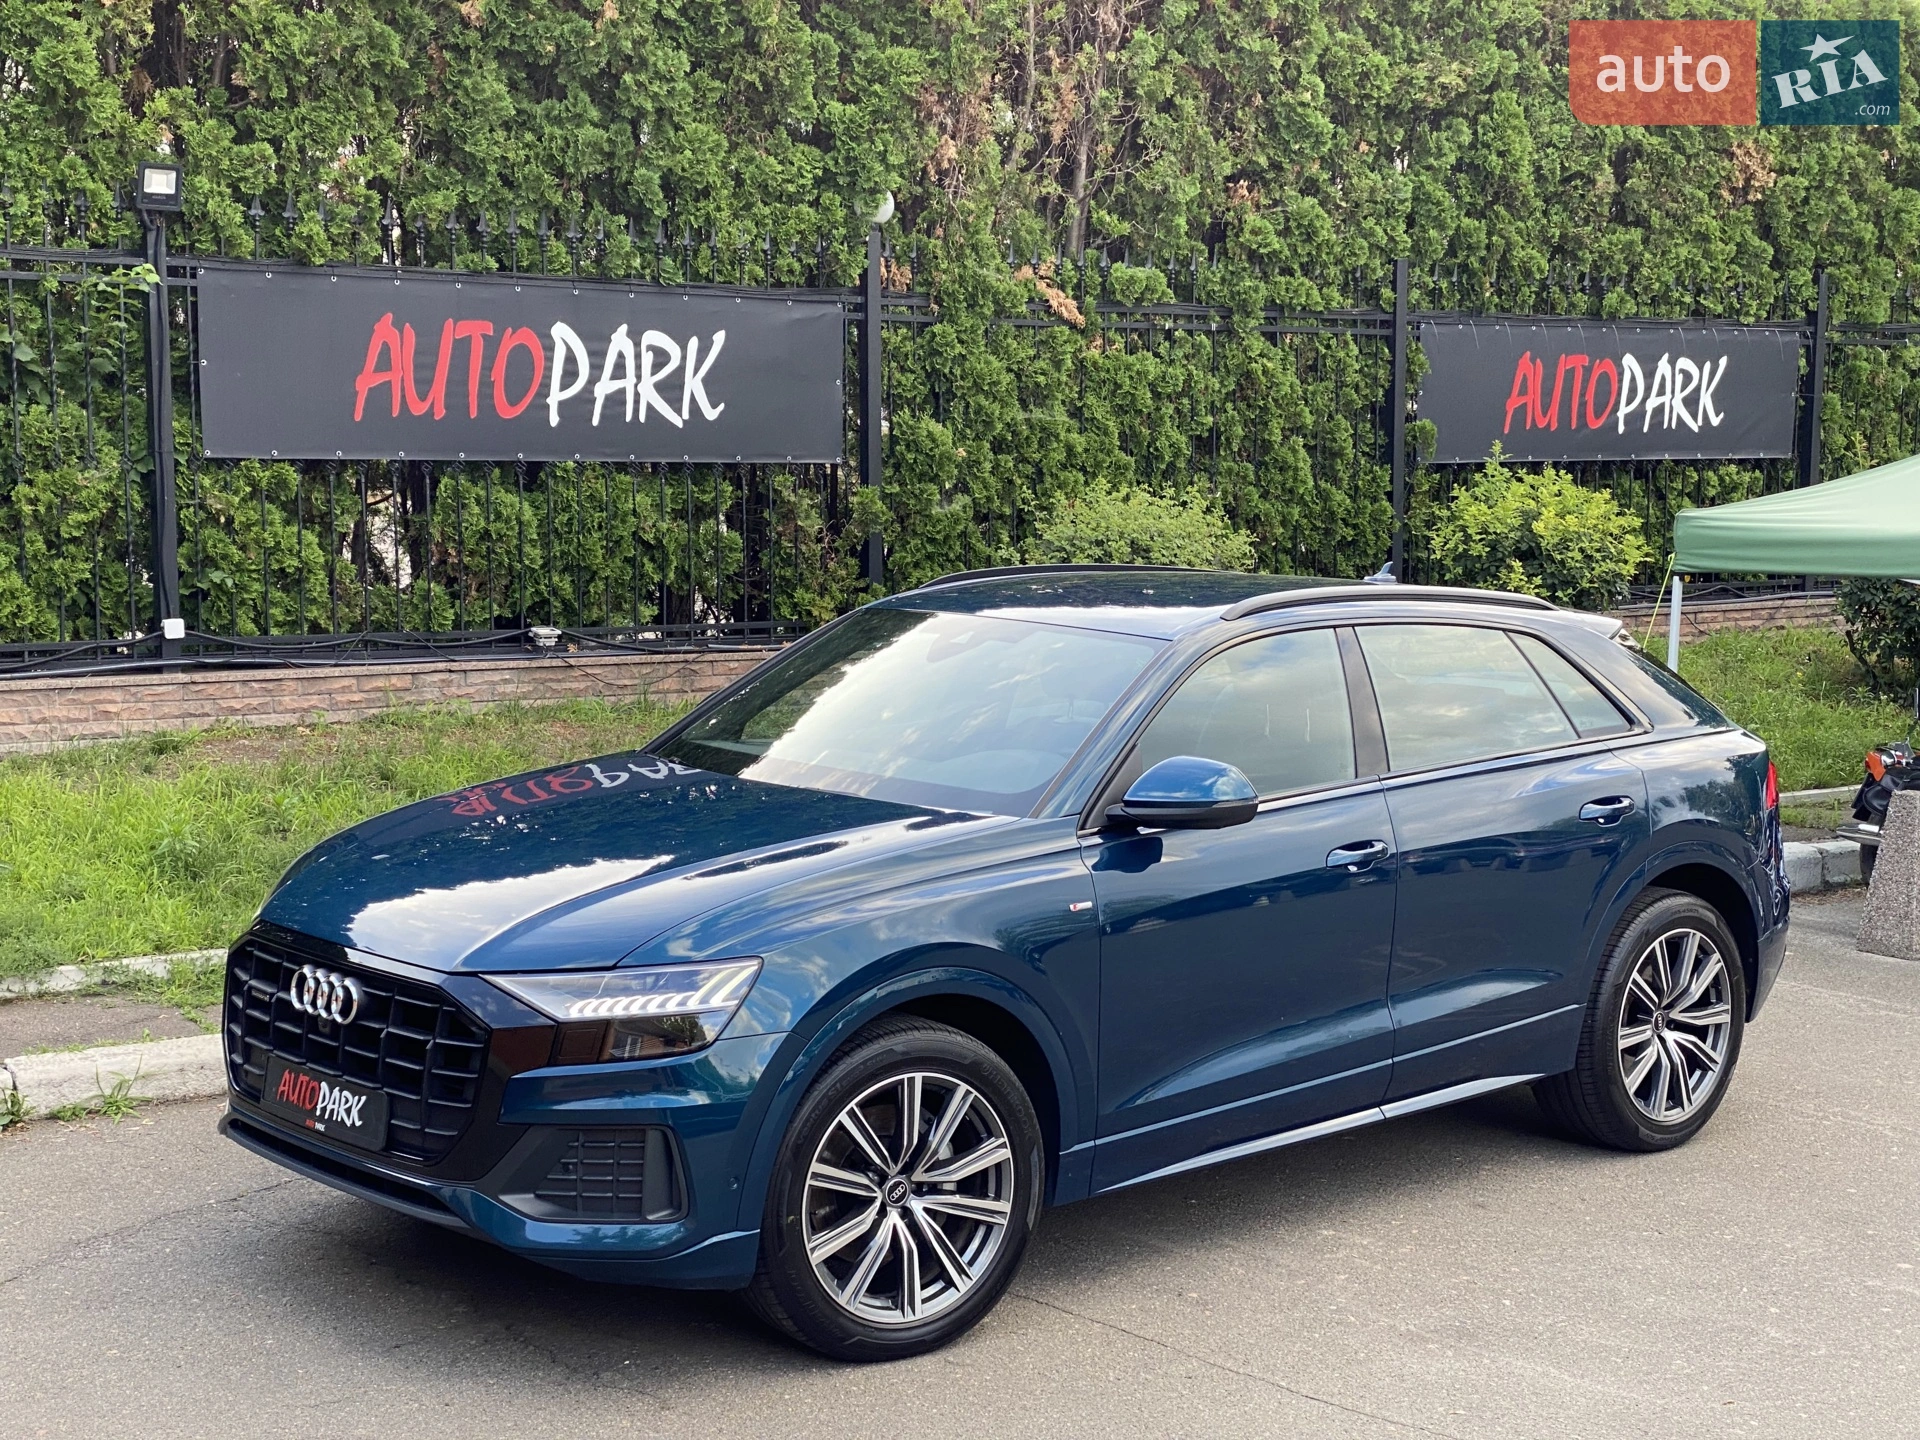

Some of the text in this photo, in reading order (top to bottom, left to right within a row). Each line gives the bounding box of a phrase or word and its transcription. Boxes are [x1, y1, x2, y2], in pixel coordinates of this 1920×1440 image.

[353, 312, 726, 428] AUTOPARK
[1504, 351, 1727, 434] AUTOPARK
[277, 1069, 367, 1127] AUTOPARK
